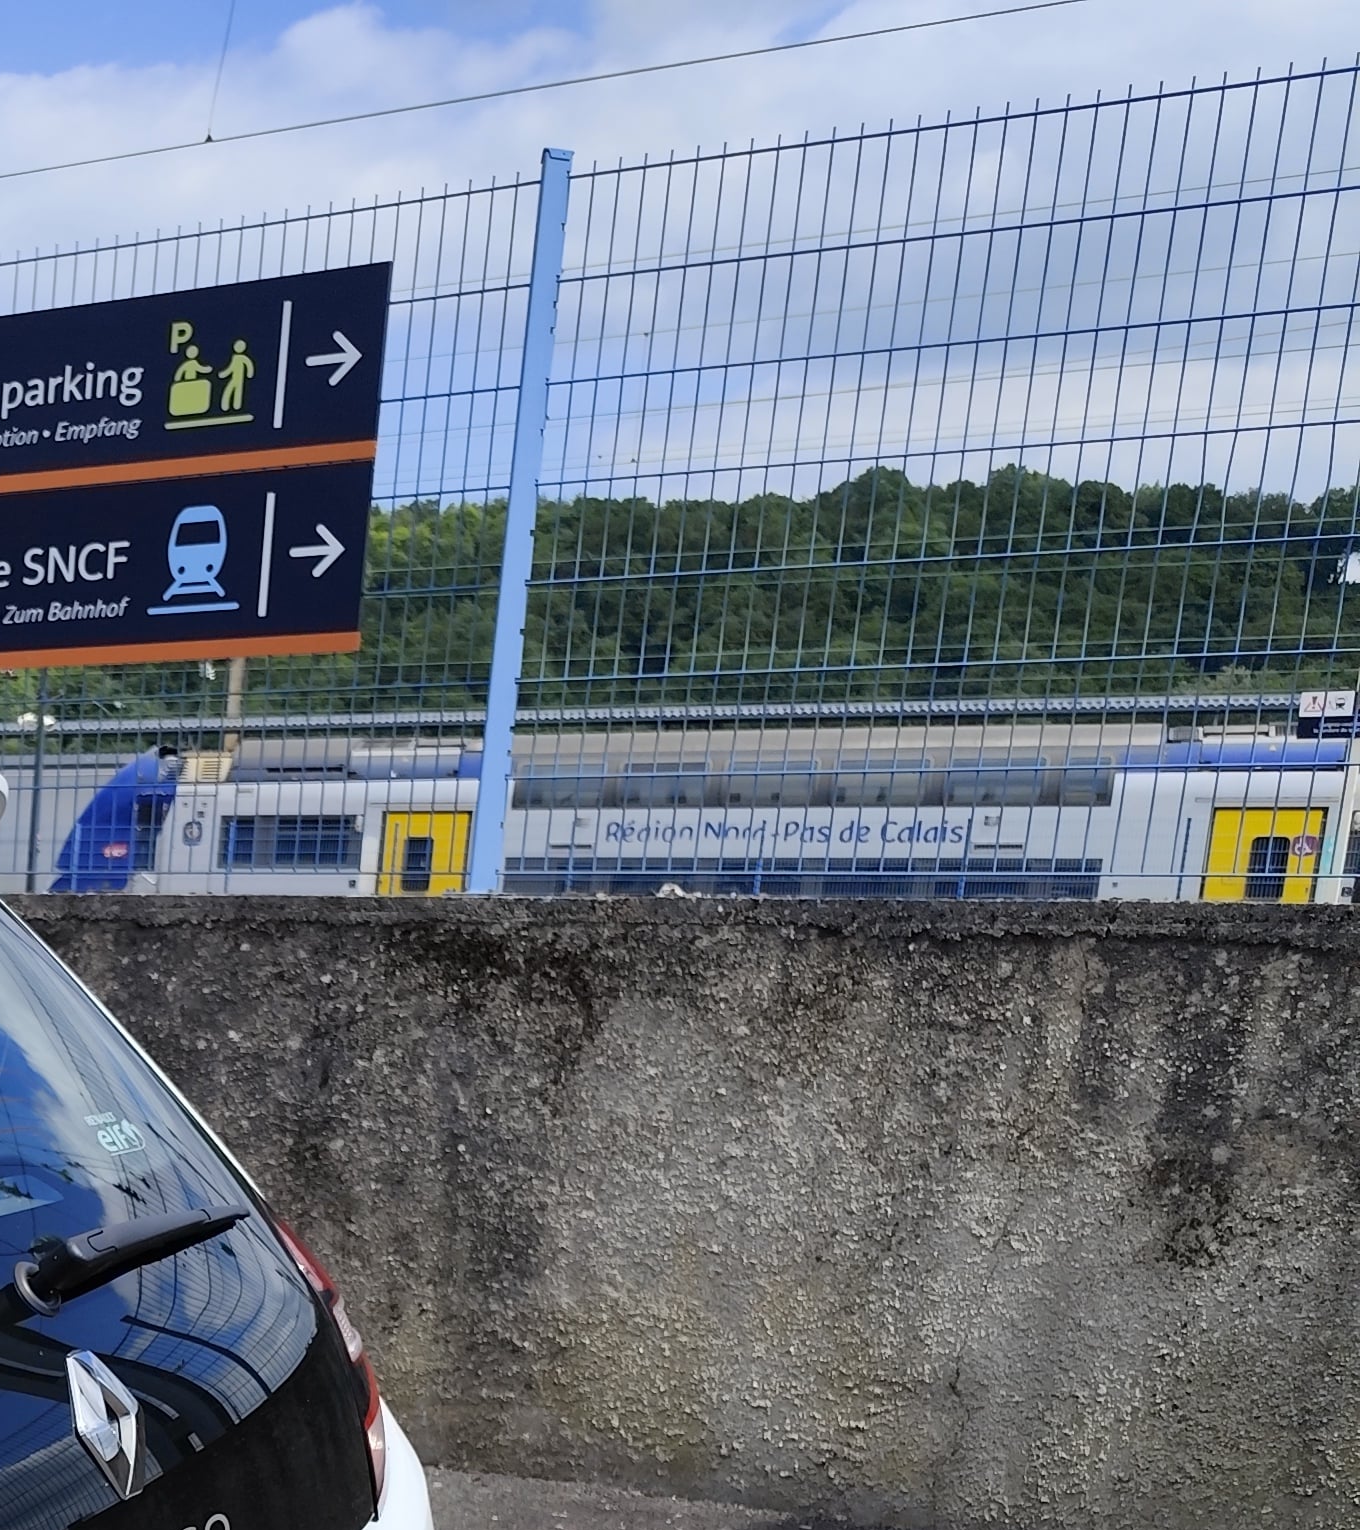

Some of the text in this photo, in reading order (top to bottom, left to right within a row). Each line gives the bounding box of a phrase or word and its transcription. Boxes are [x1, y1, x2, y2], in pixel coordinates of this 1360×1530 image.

[0, 362, 145, 420] parking
[54, 417, 143, 445] Empfang
[22, 541, 131, 586] SNCF
[2, 605, 44, 625] Zum
[47, 597, 131, 622] Bahnhof
[605, 820, 693, 845] Région
[839, 819, 871, 844] de
[880, 819, 964, 844] Calais
